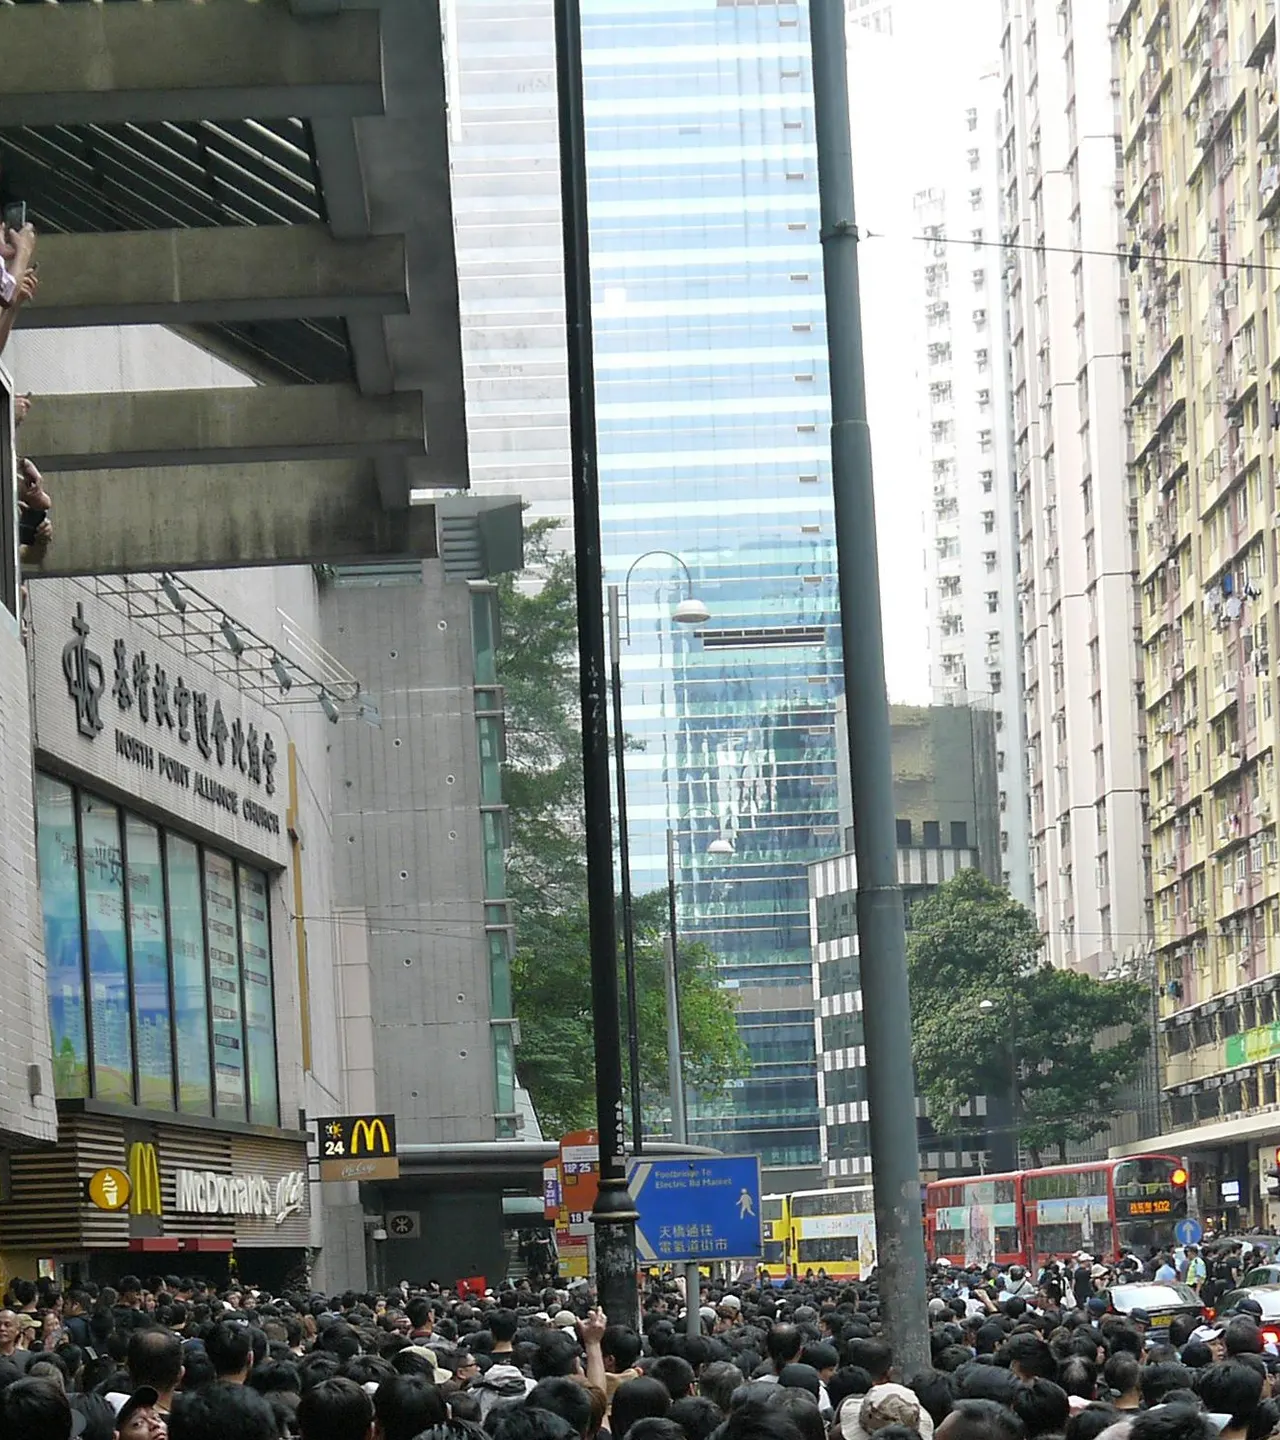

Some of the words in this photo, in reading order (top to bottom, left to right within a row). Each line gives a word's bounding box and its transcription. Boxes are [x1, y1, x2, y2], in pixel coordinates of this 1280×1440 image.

[115, 728, 154, 770] NORTH
[159, 751, 190, 789] POINT
[194, 771, 239, 815] ALLIANCE
[243, 798, 280, 835] CHURCH
[324, 1141, 345, 1155] 24
[579, 1162, 591, 1173] 25
[175, 1168, 271, 1215] McDonald's
[655, 1180, 687, 1189] Electric
[1153, 1200, 1170, 1212] 102
[570, 1213, 582, 1223] 18
[659, 1223, 713, 1239] 天橋通往
[658, 1238, 728, 1253] 電氣道街市
